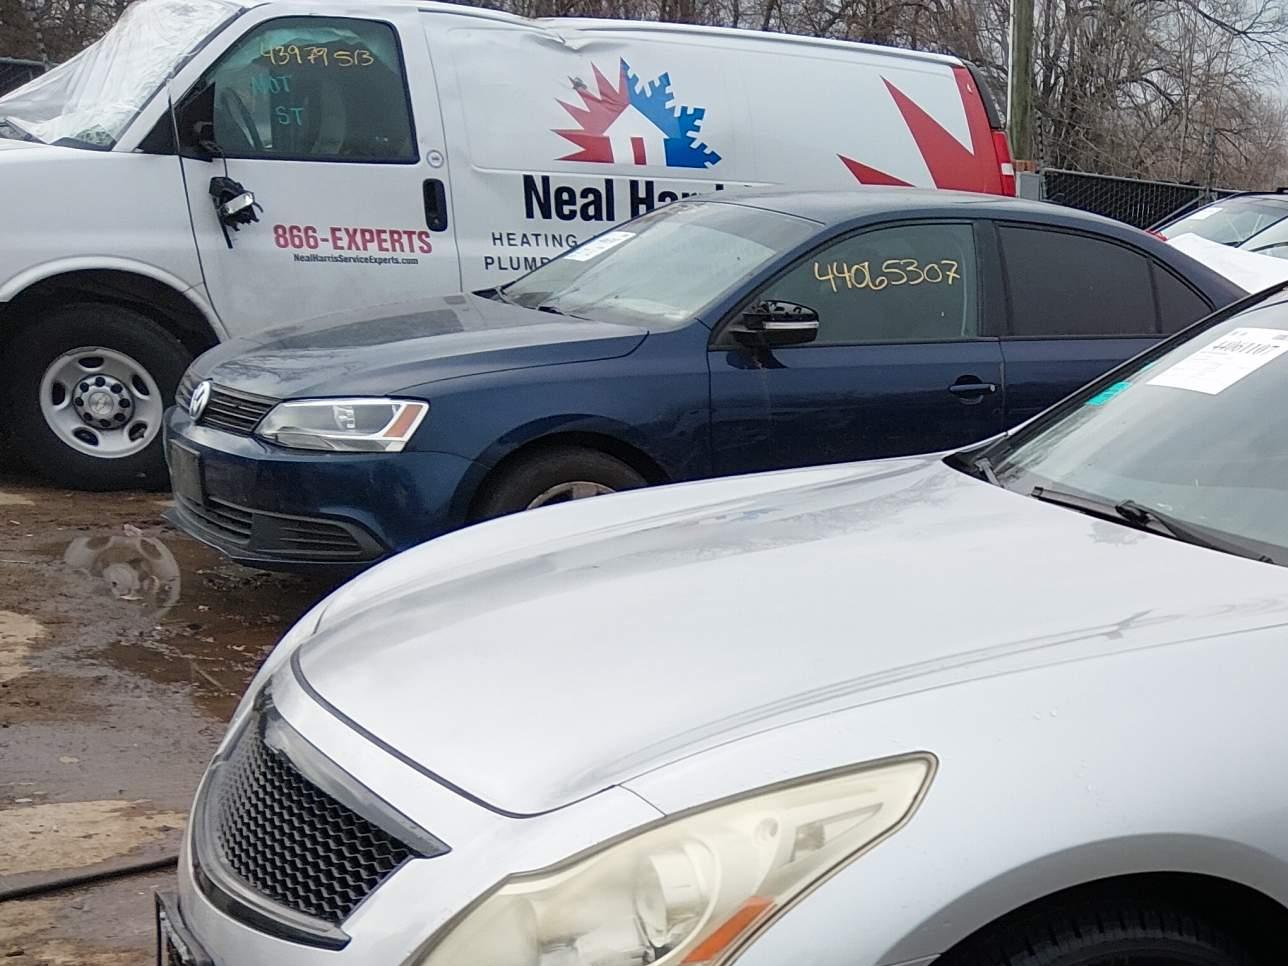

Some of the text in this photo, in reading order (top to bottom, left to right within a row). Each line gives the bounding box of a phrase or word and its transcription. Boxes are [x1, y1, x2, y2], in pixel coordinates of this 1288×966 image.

[275, 105, 304, 126] ST
[522, 174, 616, 222] Neal
[273, 224, 433, 254] 866-EXPERTS
[491, 232, 579, 248] HEATING
[293, 254, 419, 265] NealHarrisServiceExperts.com
[814, 258, 960, 293] 44065307
